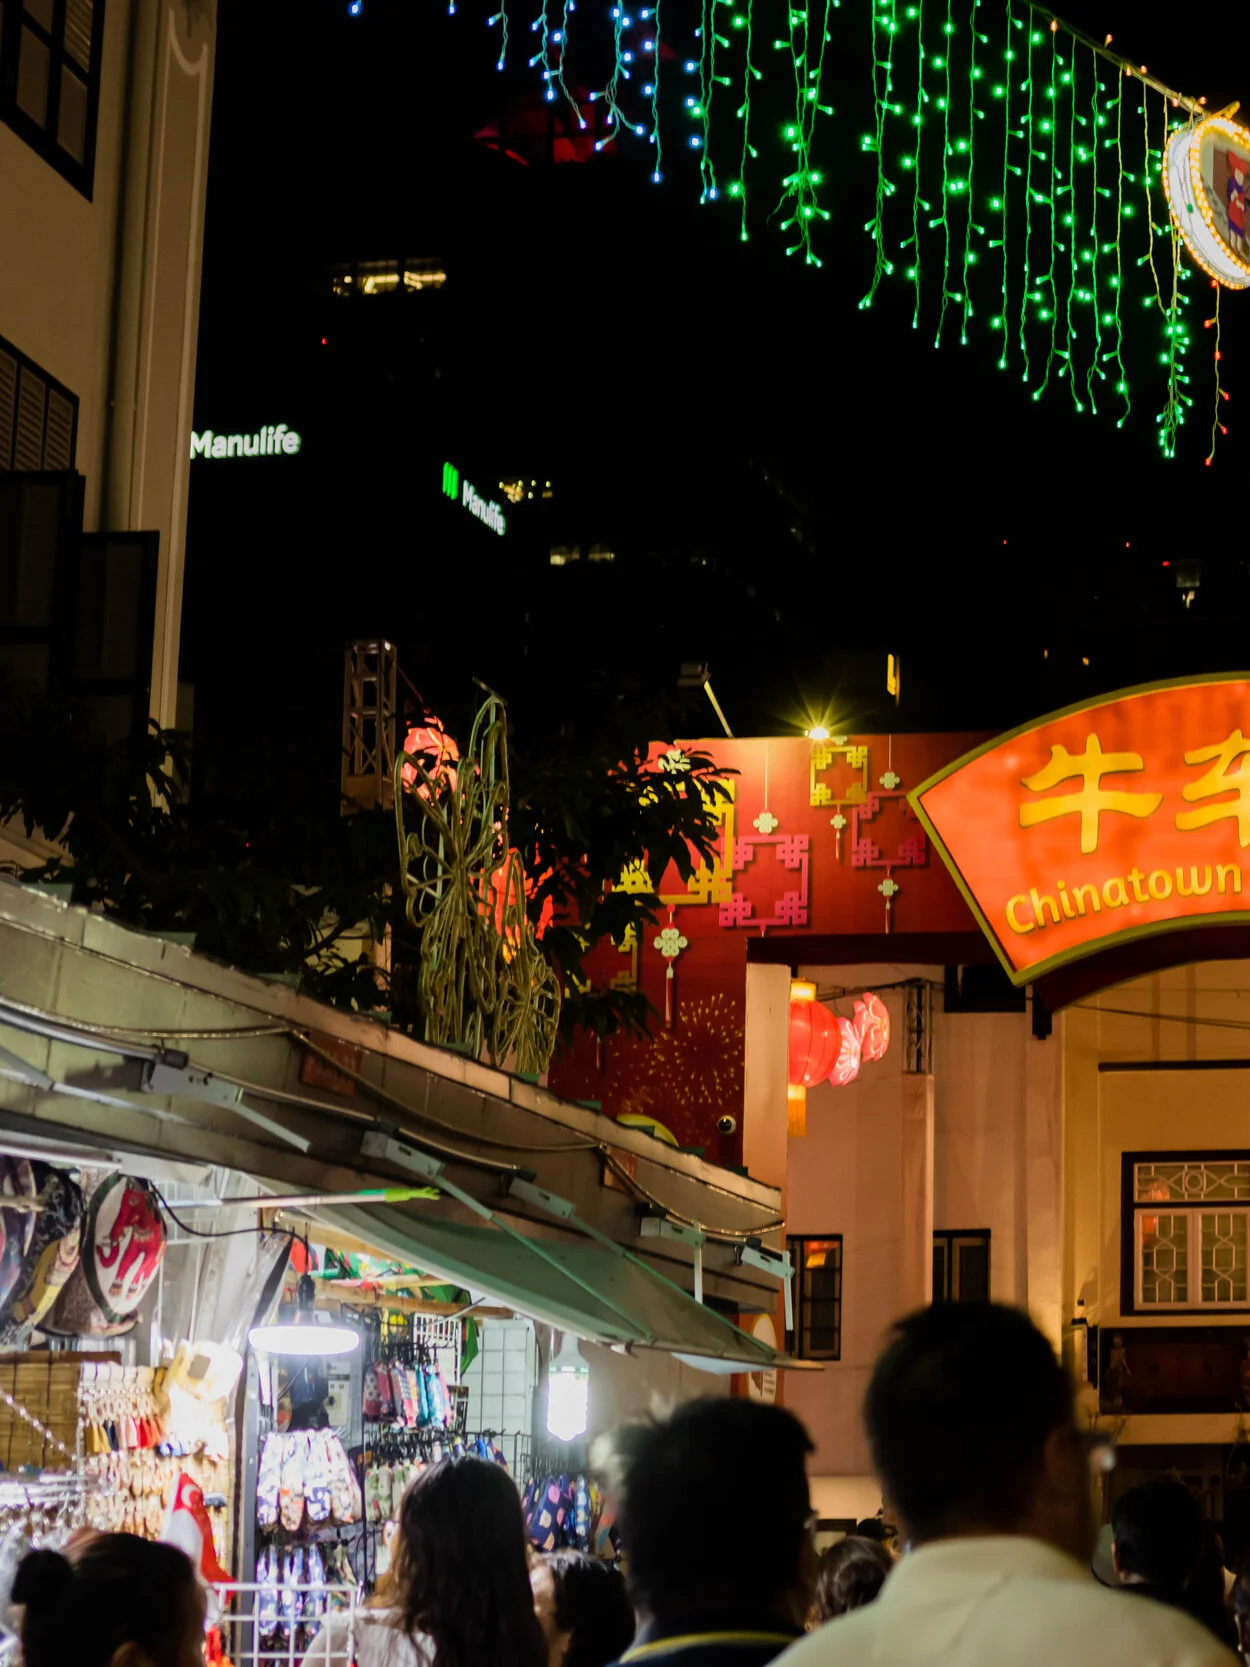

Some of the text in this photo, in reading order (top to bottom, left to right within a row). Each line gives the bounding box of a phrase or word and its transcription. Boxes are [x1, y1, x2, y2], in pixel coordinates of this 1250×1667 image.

[190, 424, 301, 459] Manulife
[463, 480, 506, 535] Manulife
[1005, 861, 1243, 936] Chinatown
